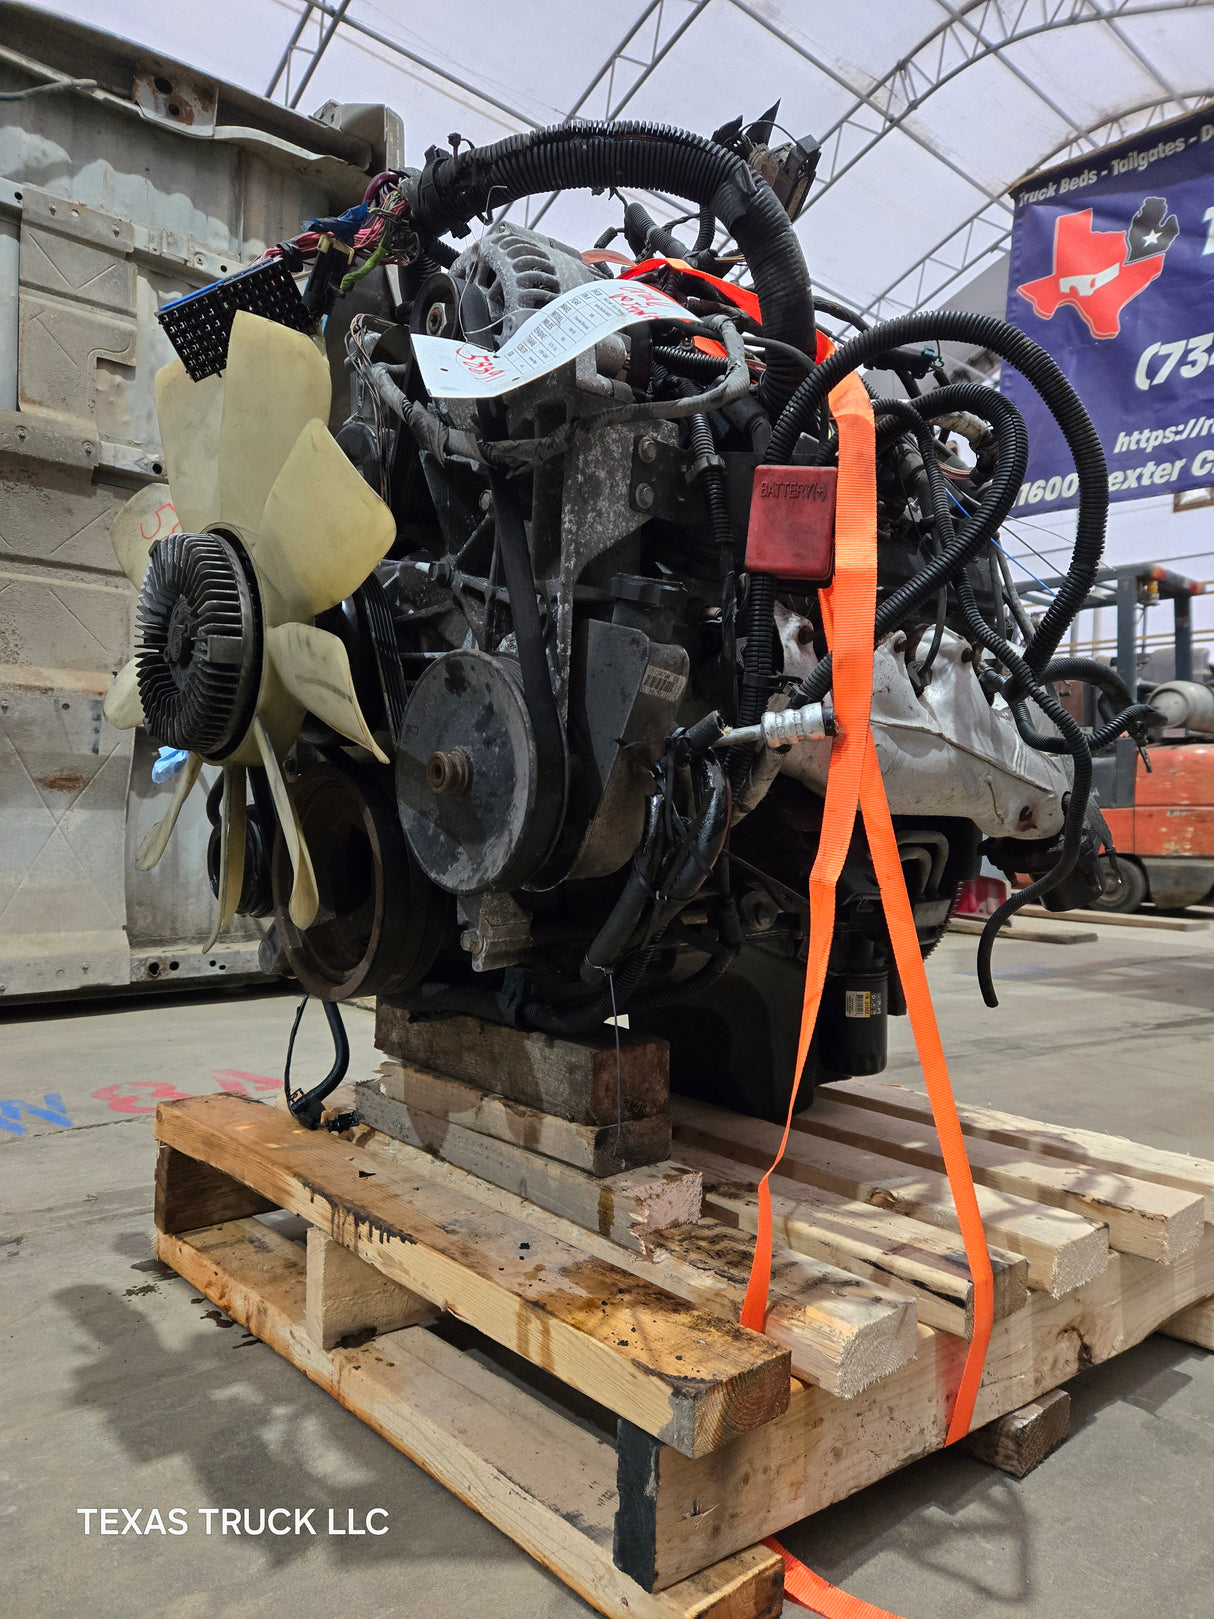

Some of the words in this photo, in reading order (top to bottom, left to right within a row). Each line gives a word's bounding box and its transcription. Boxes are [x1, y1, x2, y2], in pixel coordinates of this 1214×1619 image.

[1018, 182, 1058, 208] Truck
[1058, 168, 1098, 194] Beds
[1110, 137, 1186, 176] Tailgates
[1200, 124, 1214, 142] D
[1134, 332, 1214, 391] (73
[1113, 416, 1214, 454] https://r
[1011, 472, 1080, 508] 1600
[1108, 457, 1187, 492] exter
[1191, 449, 1214, 477] C
